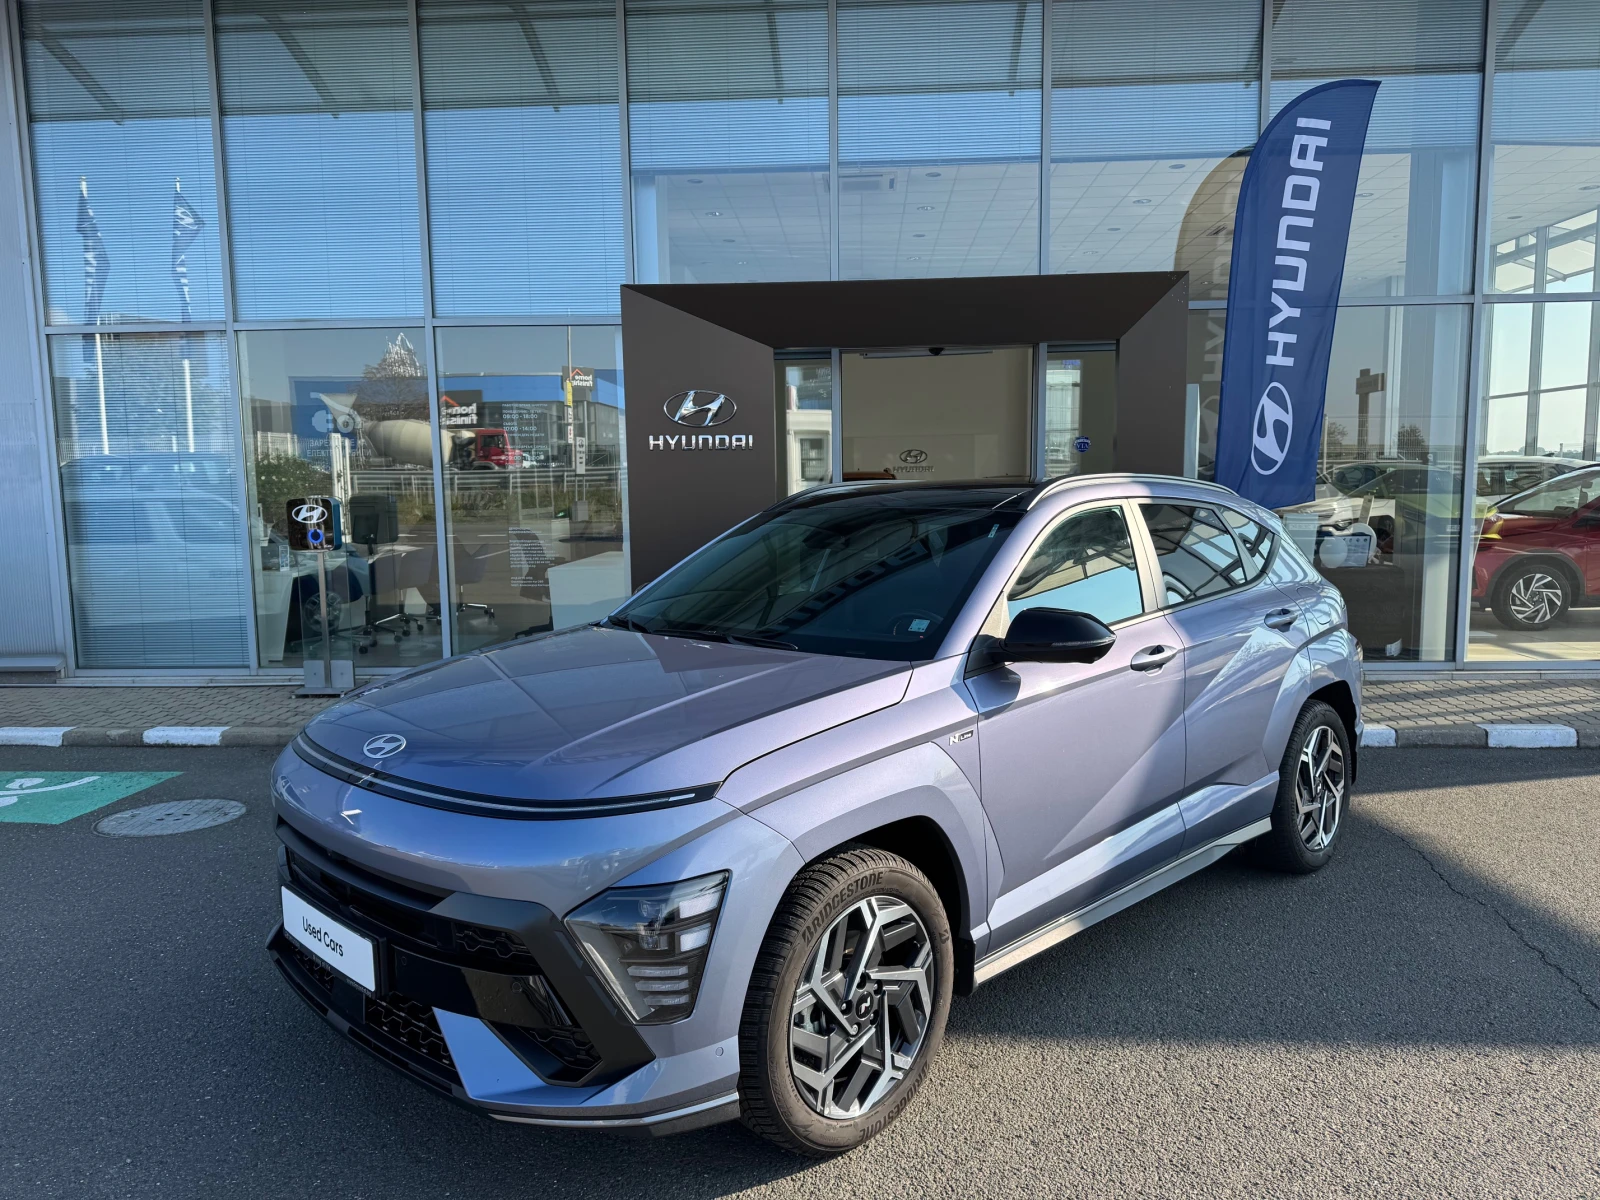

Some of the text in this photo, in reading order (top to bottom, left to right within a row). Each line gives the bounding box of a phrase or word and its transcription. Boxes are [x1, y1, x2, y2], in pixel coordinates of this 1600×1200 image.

[1266, 117, 1331, 367] HYUNDAI
[649, 435, 753, 450] HYUNDAI
[892, 465, 935, 473] HYUNDAI
[802, 872, 884, 946] BRIDGESTONE
[302, 916, 322, 942] Used
[323, 931, 344, 957] Cars
